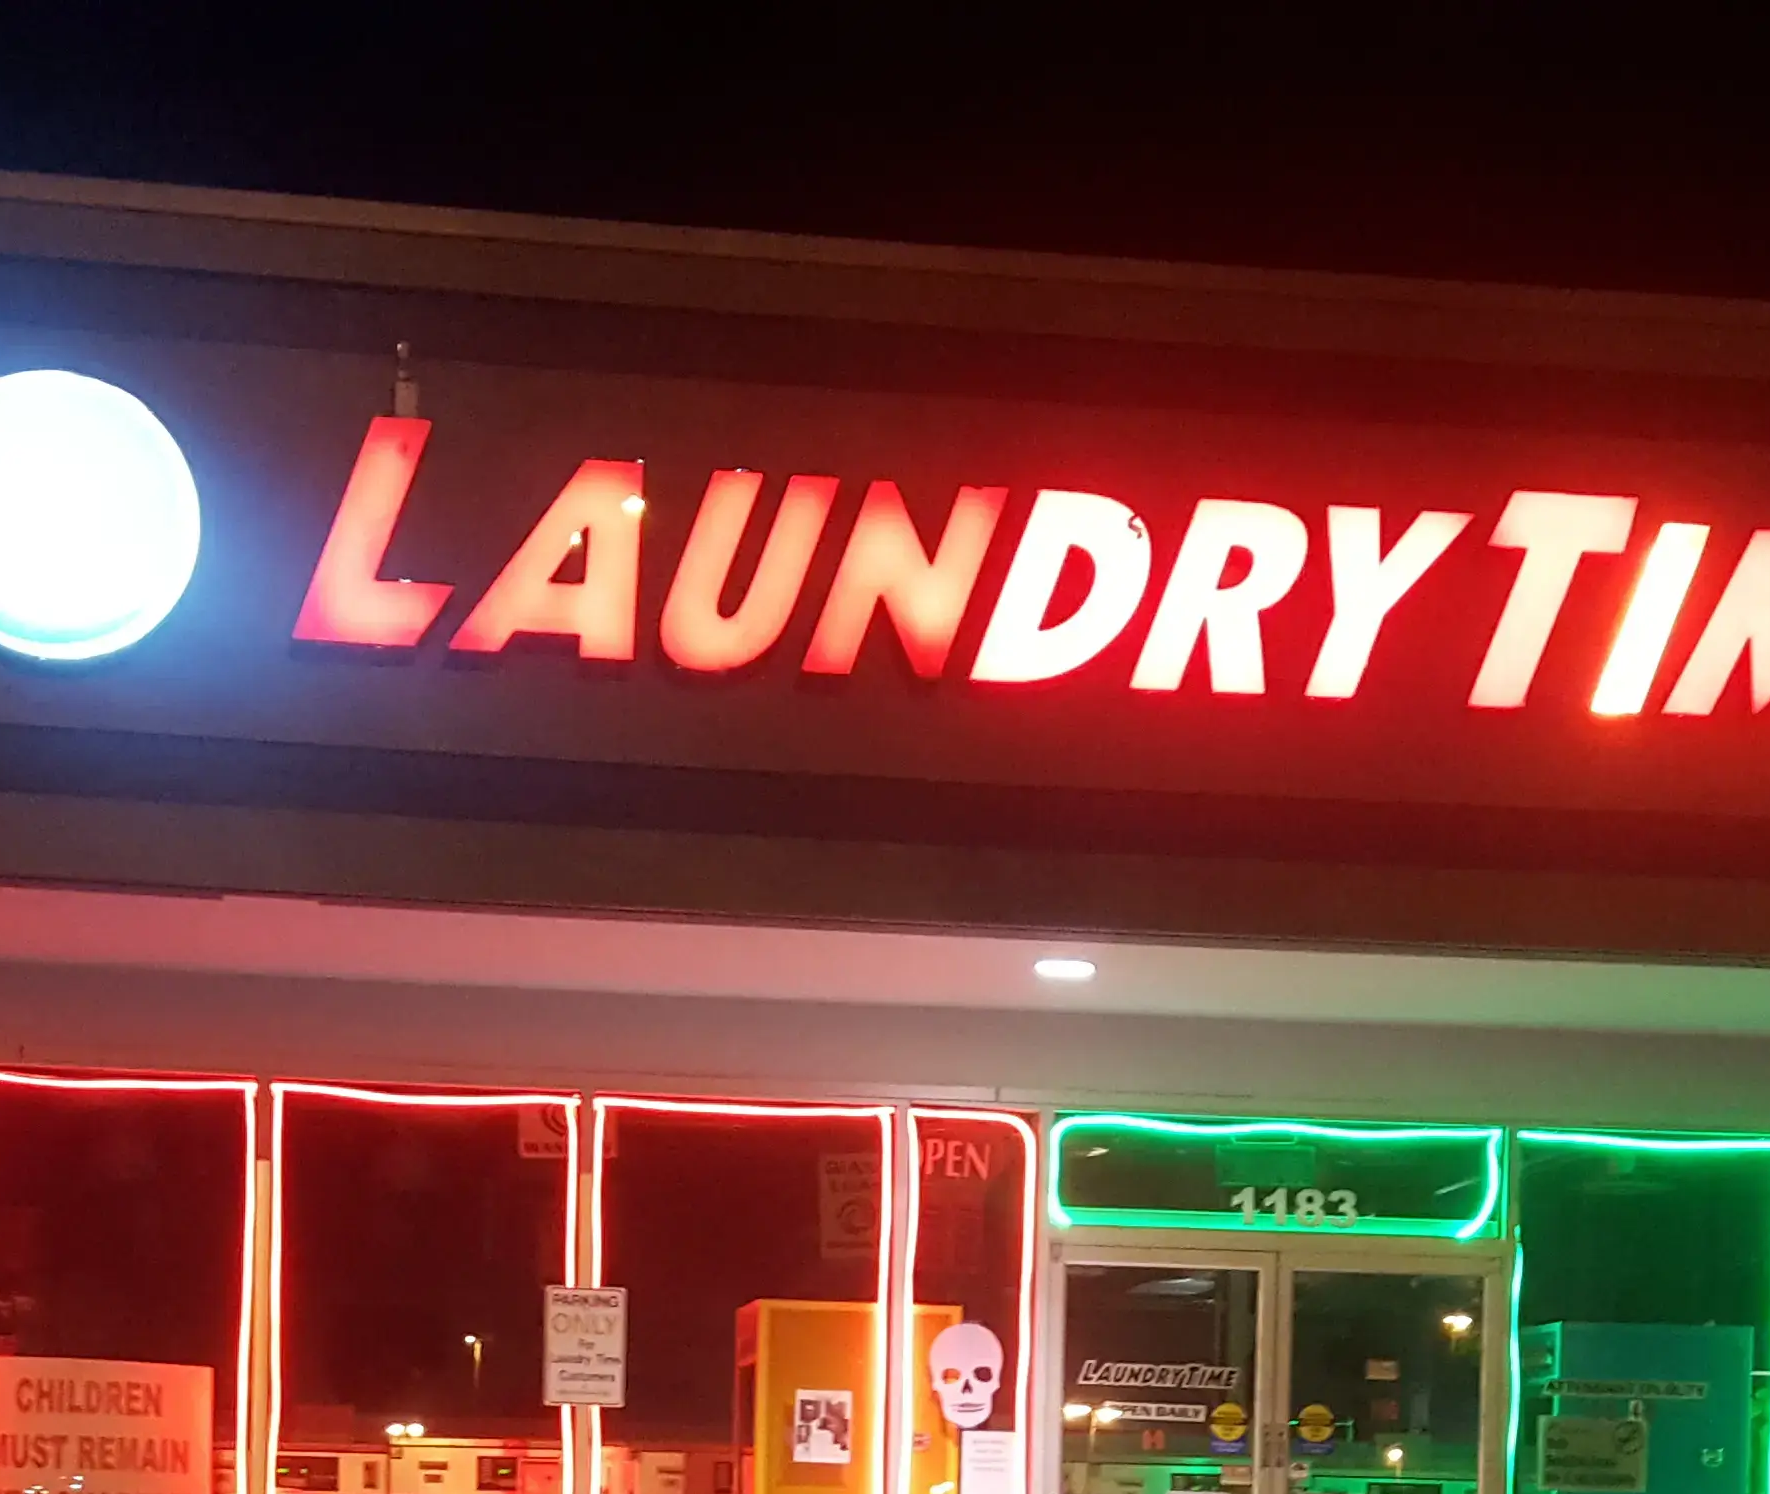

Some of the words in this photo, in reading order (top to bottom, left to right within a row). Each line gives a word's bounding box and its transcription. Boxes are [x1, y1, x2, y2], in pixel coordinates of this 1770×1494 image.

[292, 416, 1475, 700] LAUNDRY
[918, 1138, 991, 1180] PEN
[1231, 1186, 1359, 1229] 1183
[552, 1293, 619, 1308] PARKING
[551, 1312, 617, 1336] ONLY
[16, 1377, 163, 1418] CHILDREN
[79, 1435, 191, 1475] REMAIN
